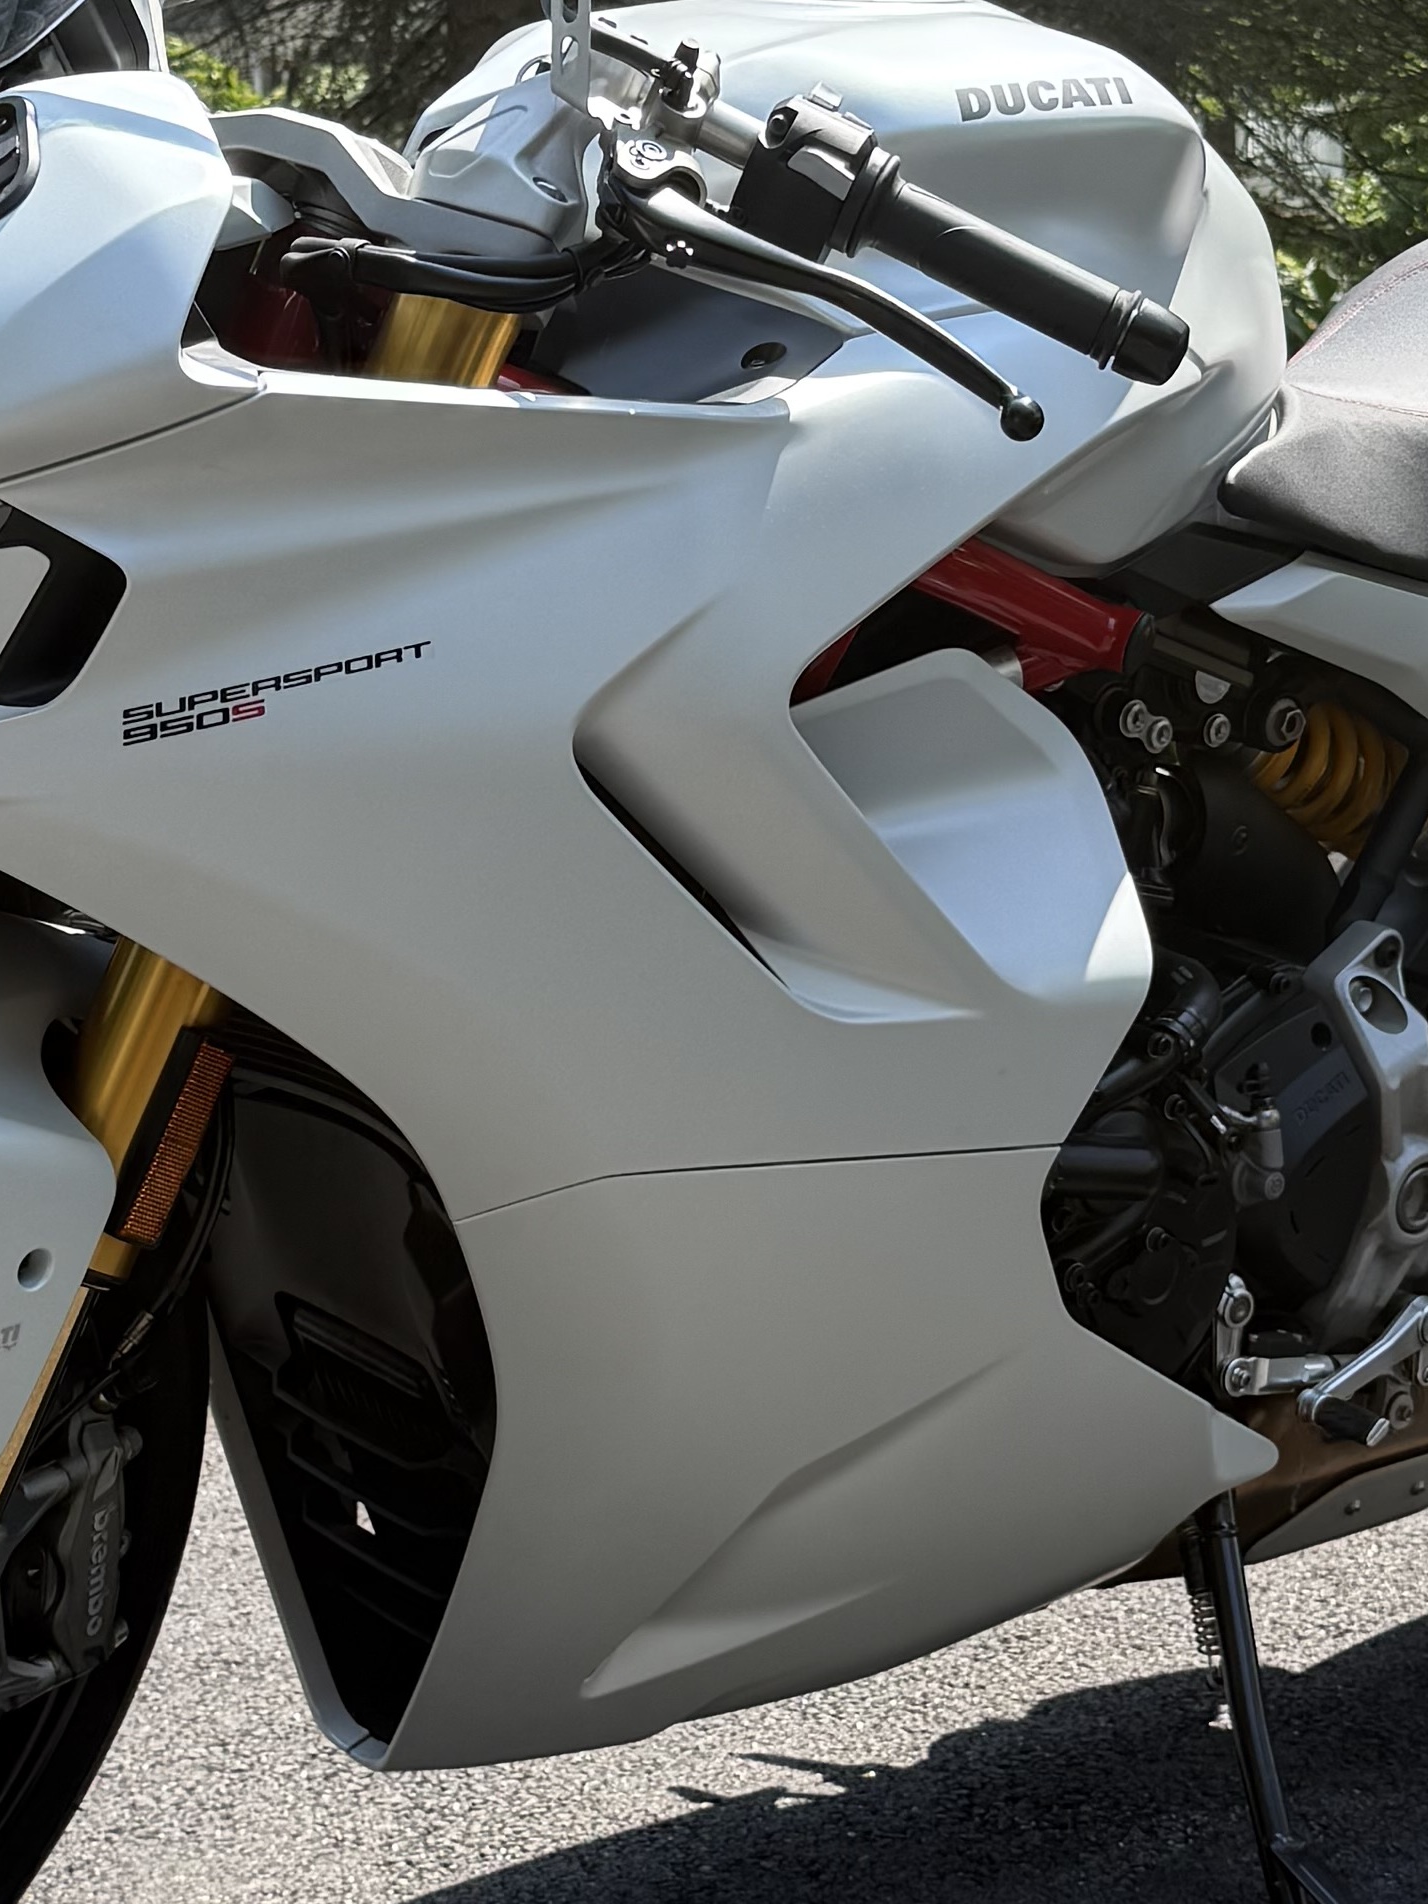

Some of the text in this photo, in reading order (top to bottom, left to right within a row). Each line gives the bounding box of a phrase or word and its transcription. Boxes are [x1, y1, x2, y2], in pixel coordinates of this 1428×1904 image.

[955, 77, 1133, 122] DUCATI
[122, 640, 431, 726] SUPERSPORT
[122, 698, 266, 747] 950S
[86, 1502, 118, 1637] brembo
